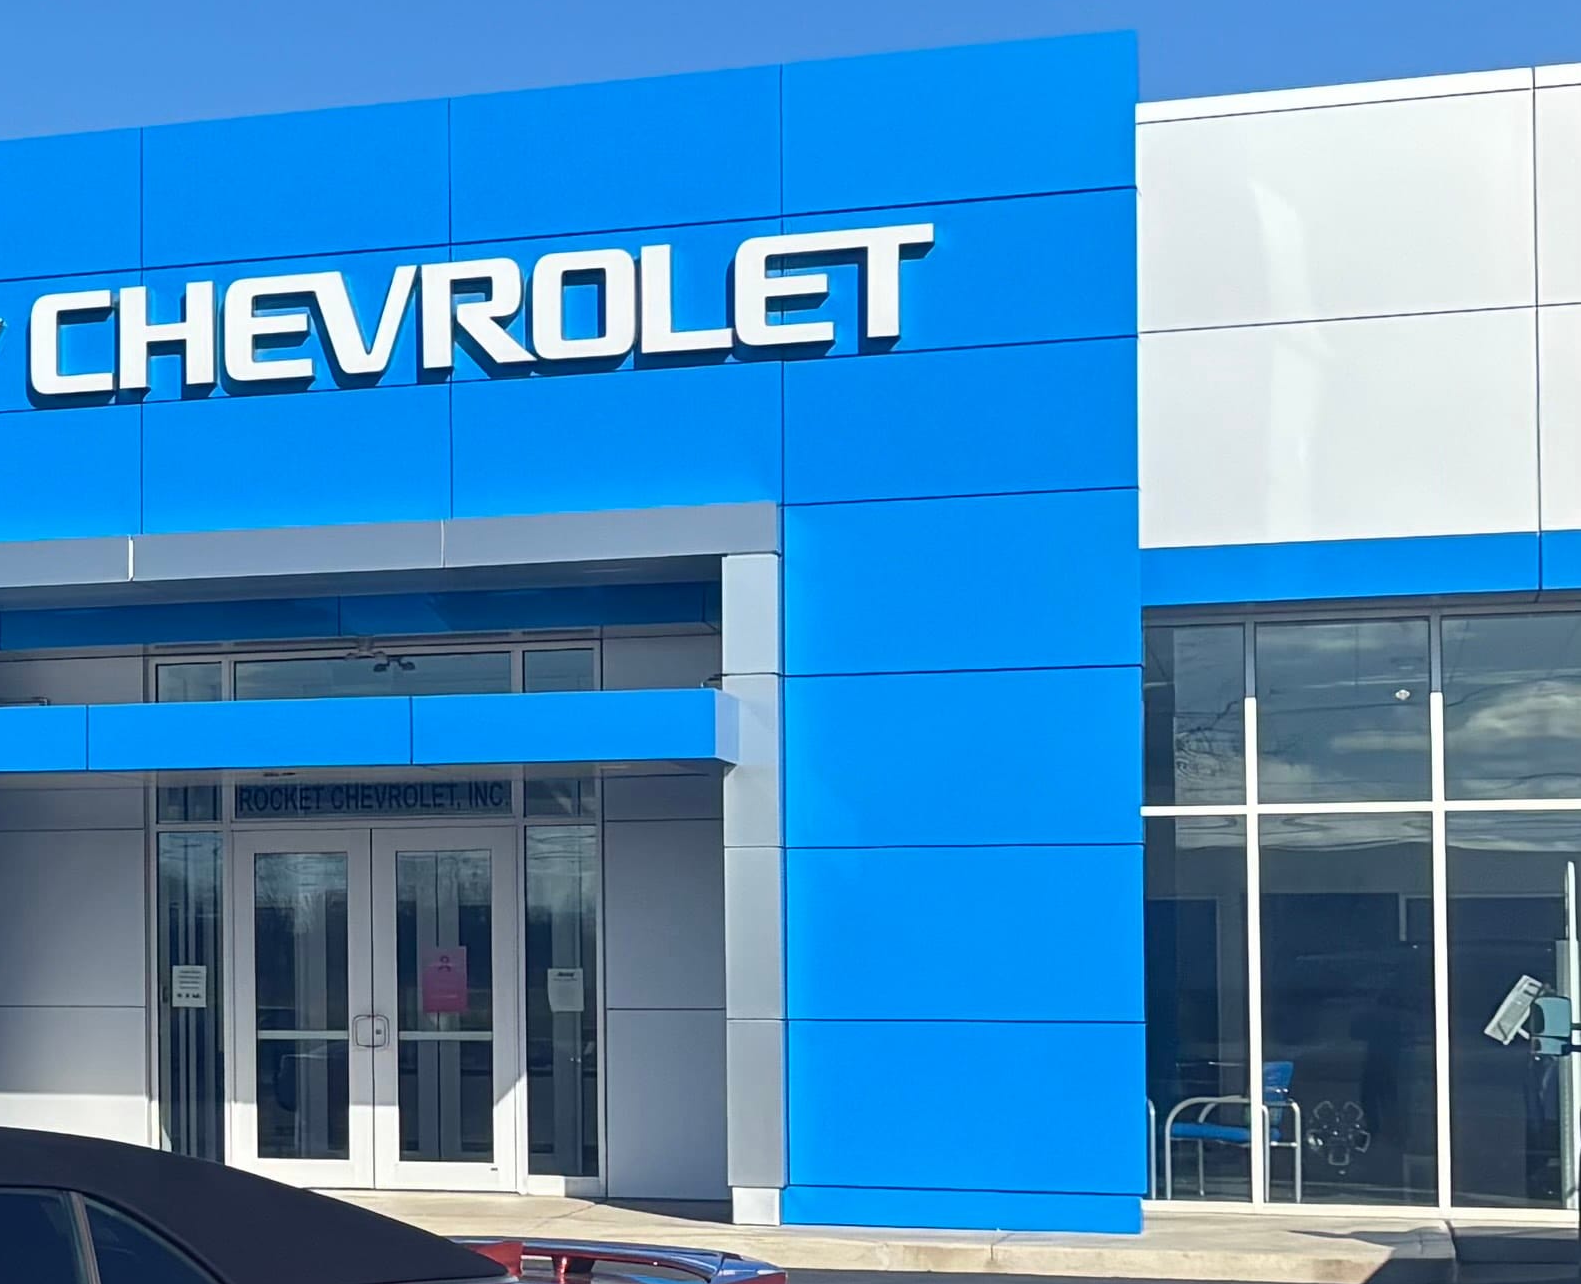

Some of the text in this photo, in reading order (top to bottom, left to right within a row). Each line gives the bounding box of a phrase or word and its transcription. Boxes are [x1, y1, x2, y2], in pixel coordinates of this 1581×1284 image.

[30, 223, 935, 399] CHEVROLET
[239, 780, 510, 812] ROCKET CHEVROLET, INC.
